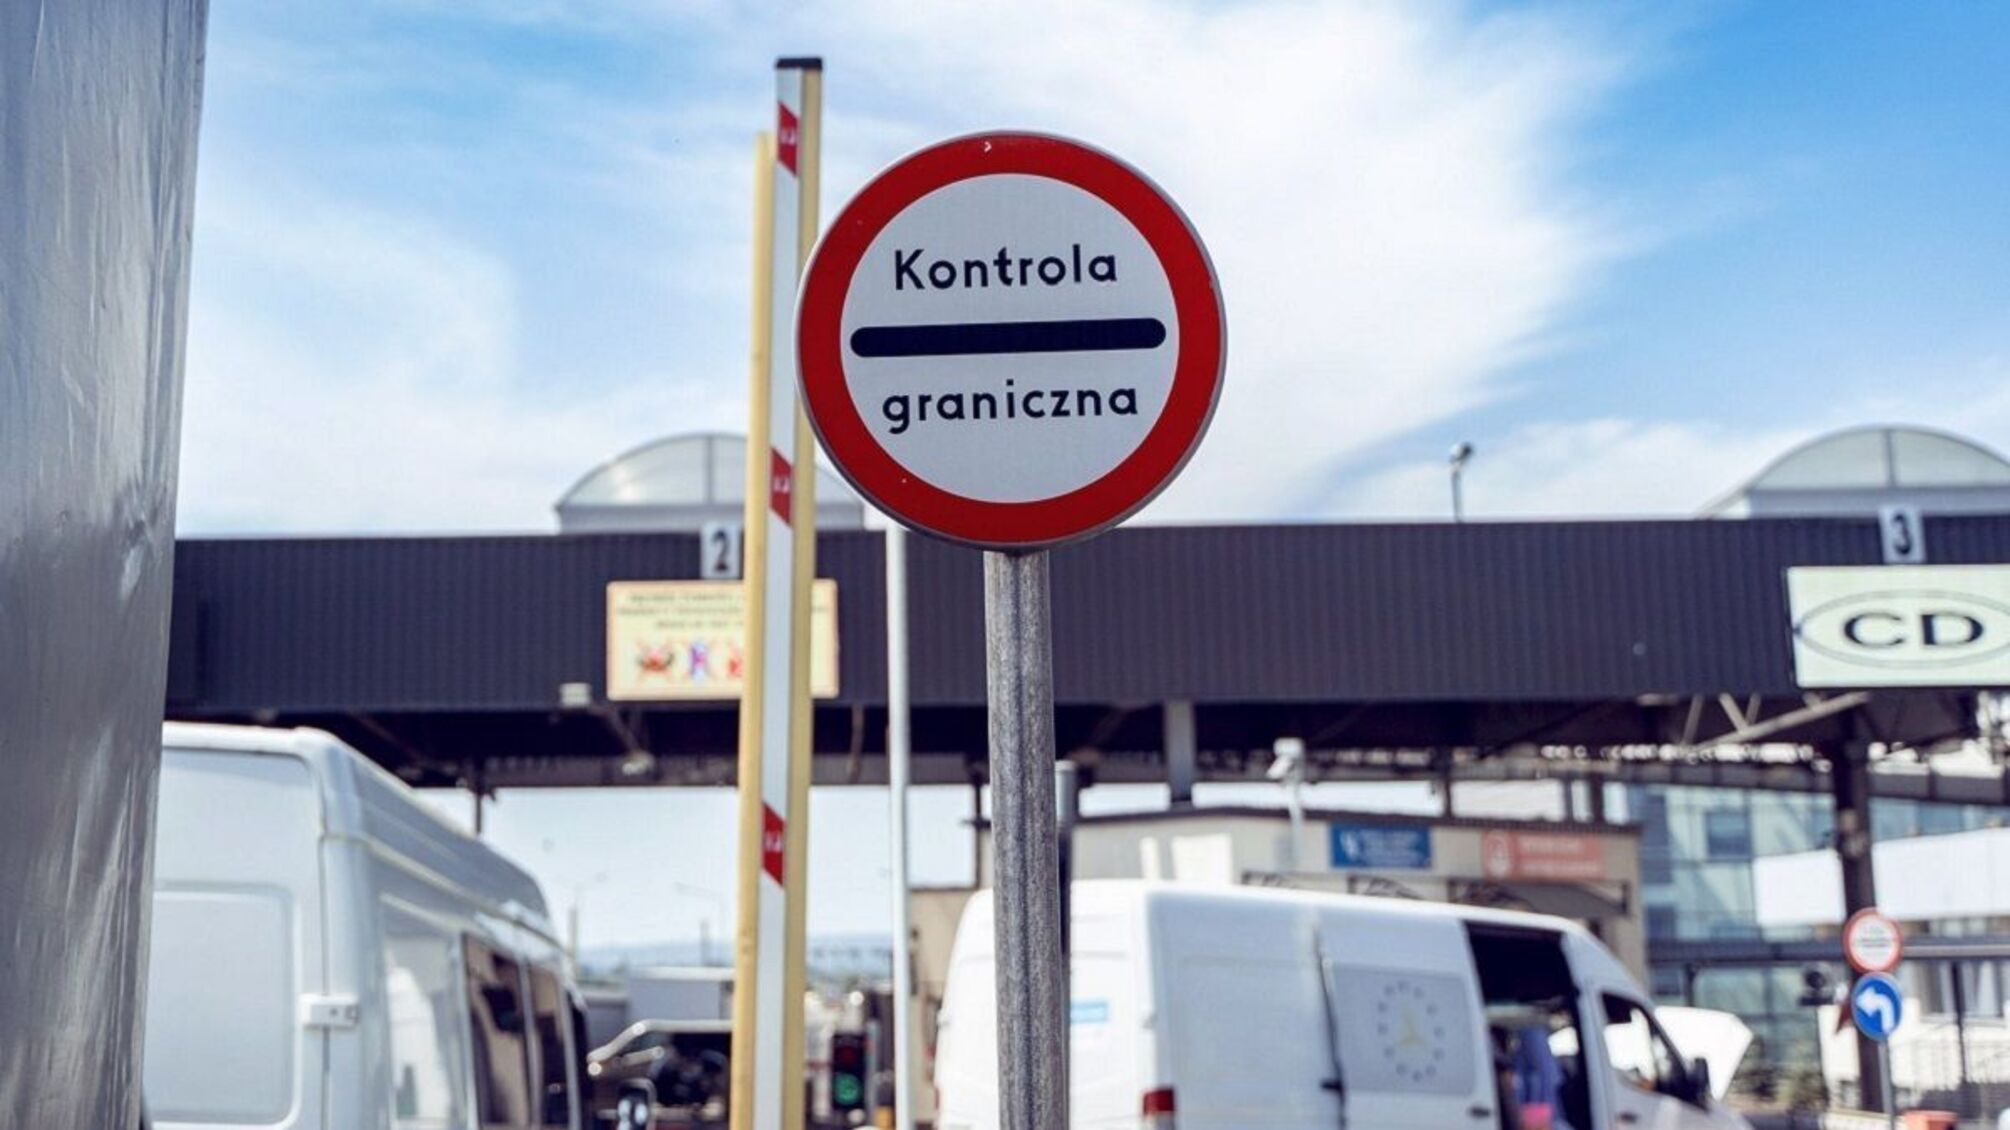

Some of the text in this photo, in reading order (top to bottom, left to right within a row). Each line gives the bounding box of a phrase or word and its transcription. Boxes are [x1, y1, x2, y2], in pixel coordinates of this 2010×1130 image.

[895, 244, 1117, 290] Kontrola
[883, 379, 1138, 434] graniczna
[711, 529, 731, 574] 2
[1893, 512, 1913, 556] 3
[1843, 611, 1984, 649] CD
